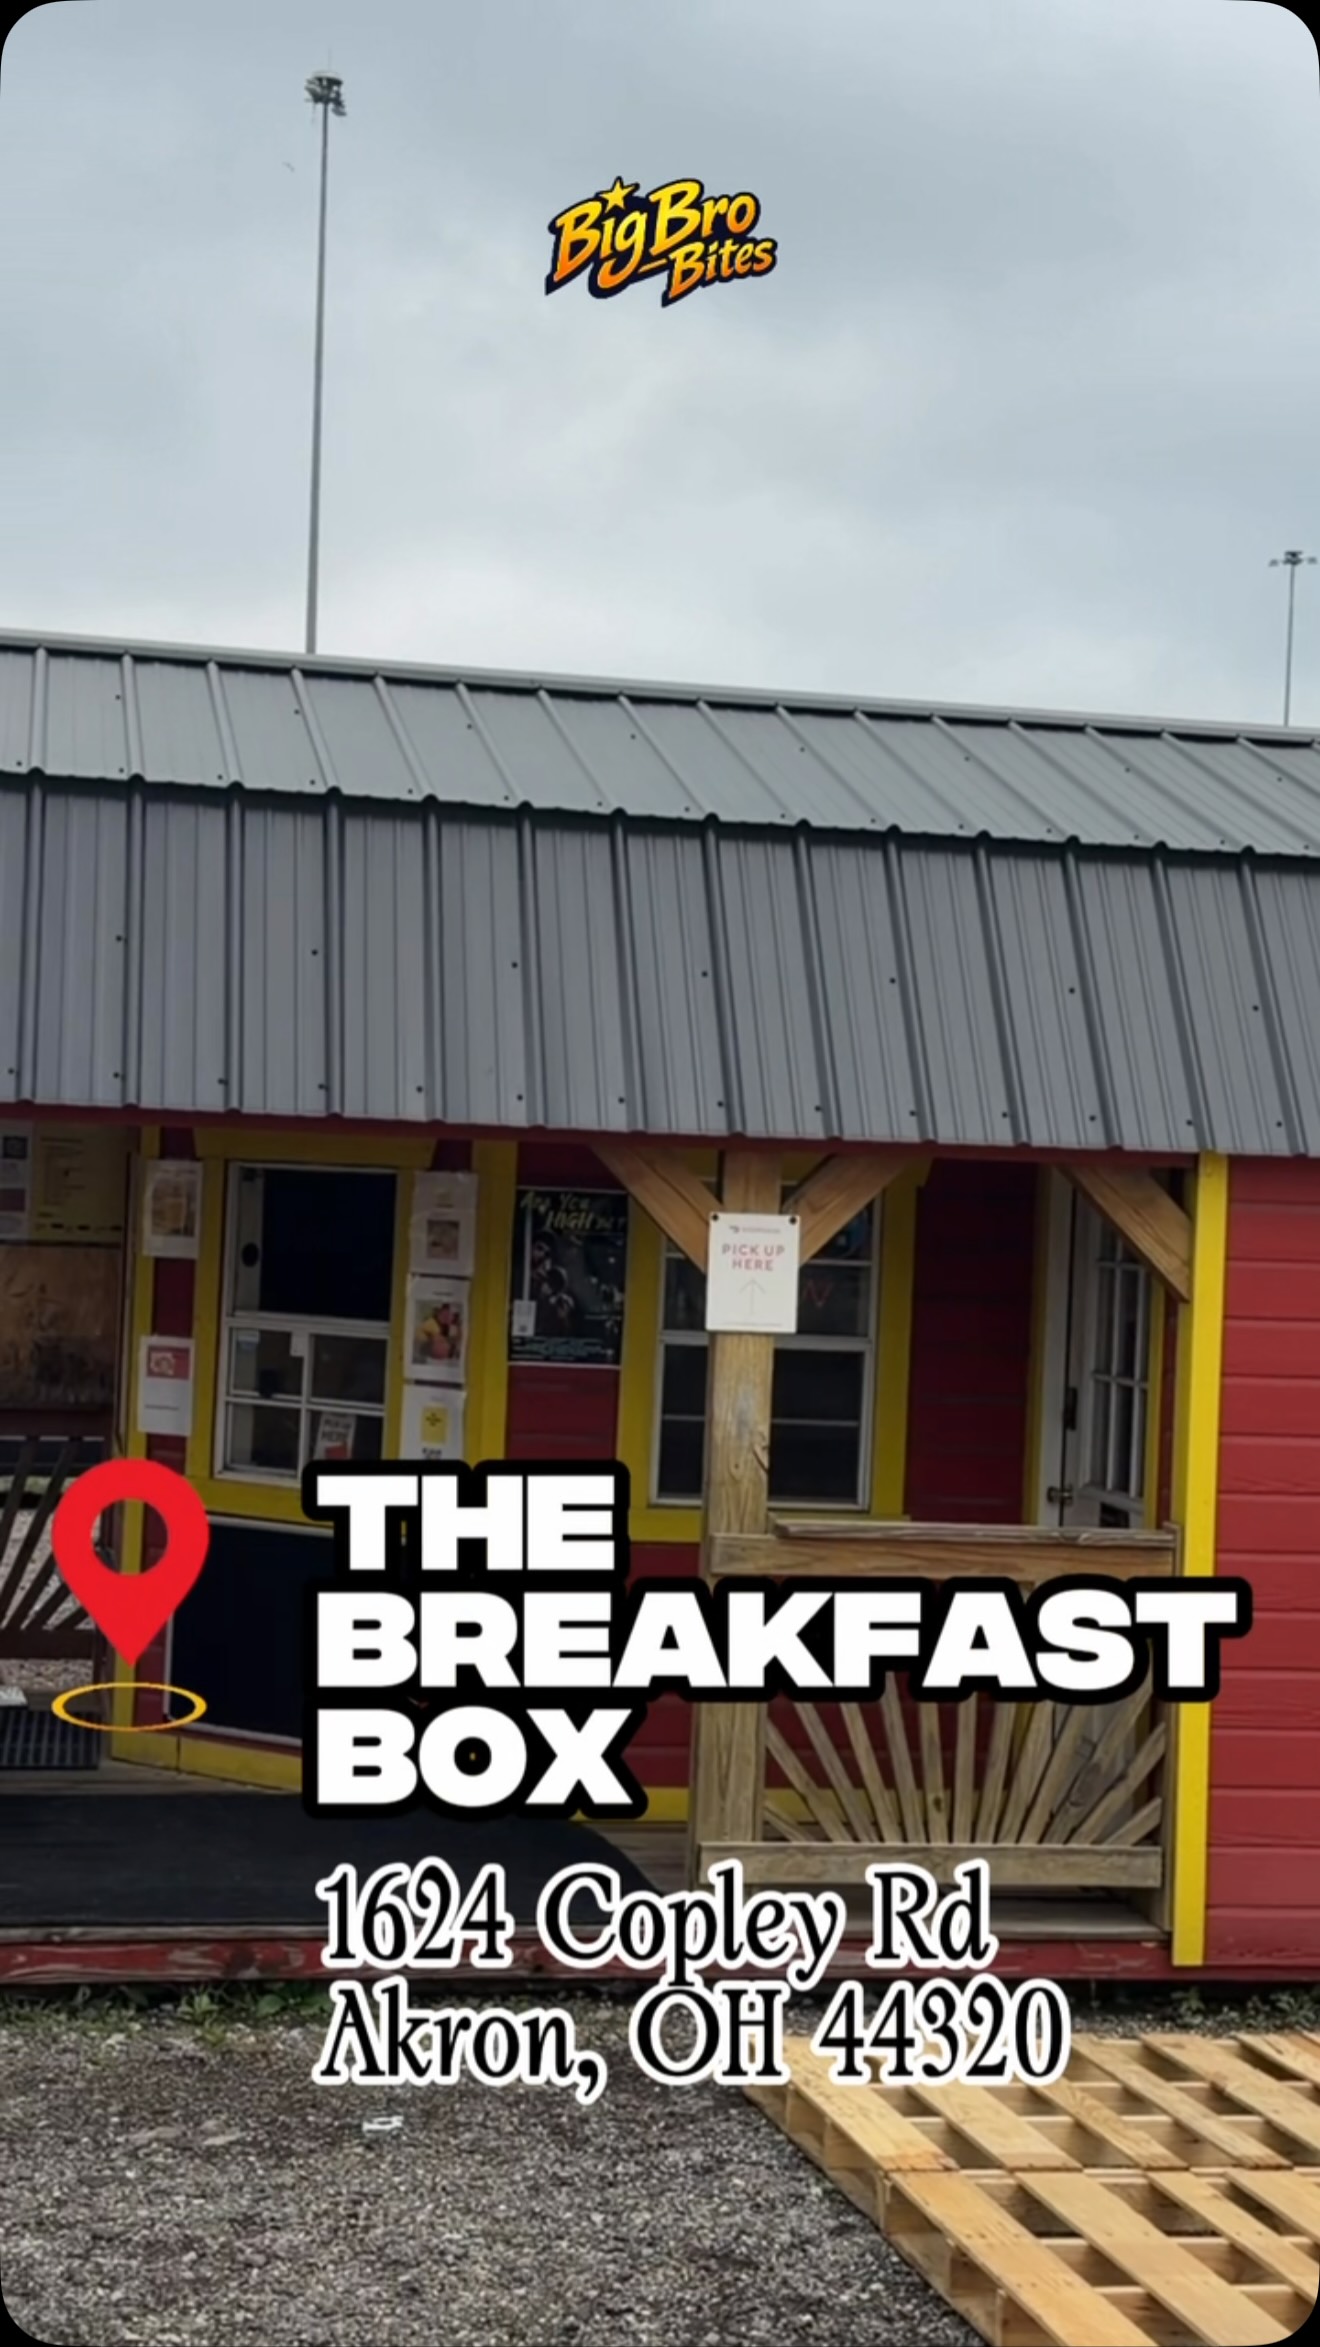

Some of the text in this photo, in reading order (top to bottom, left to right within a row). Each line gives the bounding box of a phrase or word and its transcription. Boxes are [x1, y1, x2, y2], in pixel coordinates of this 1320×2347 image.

[720, 1243, 786, 1257] PICK UP
[731, 1258, 774, 1272] HERE
